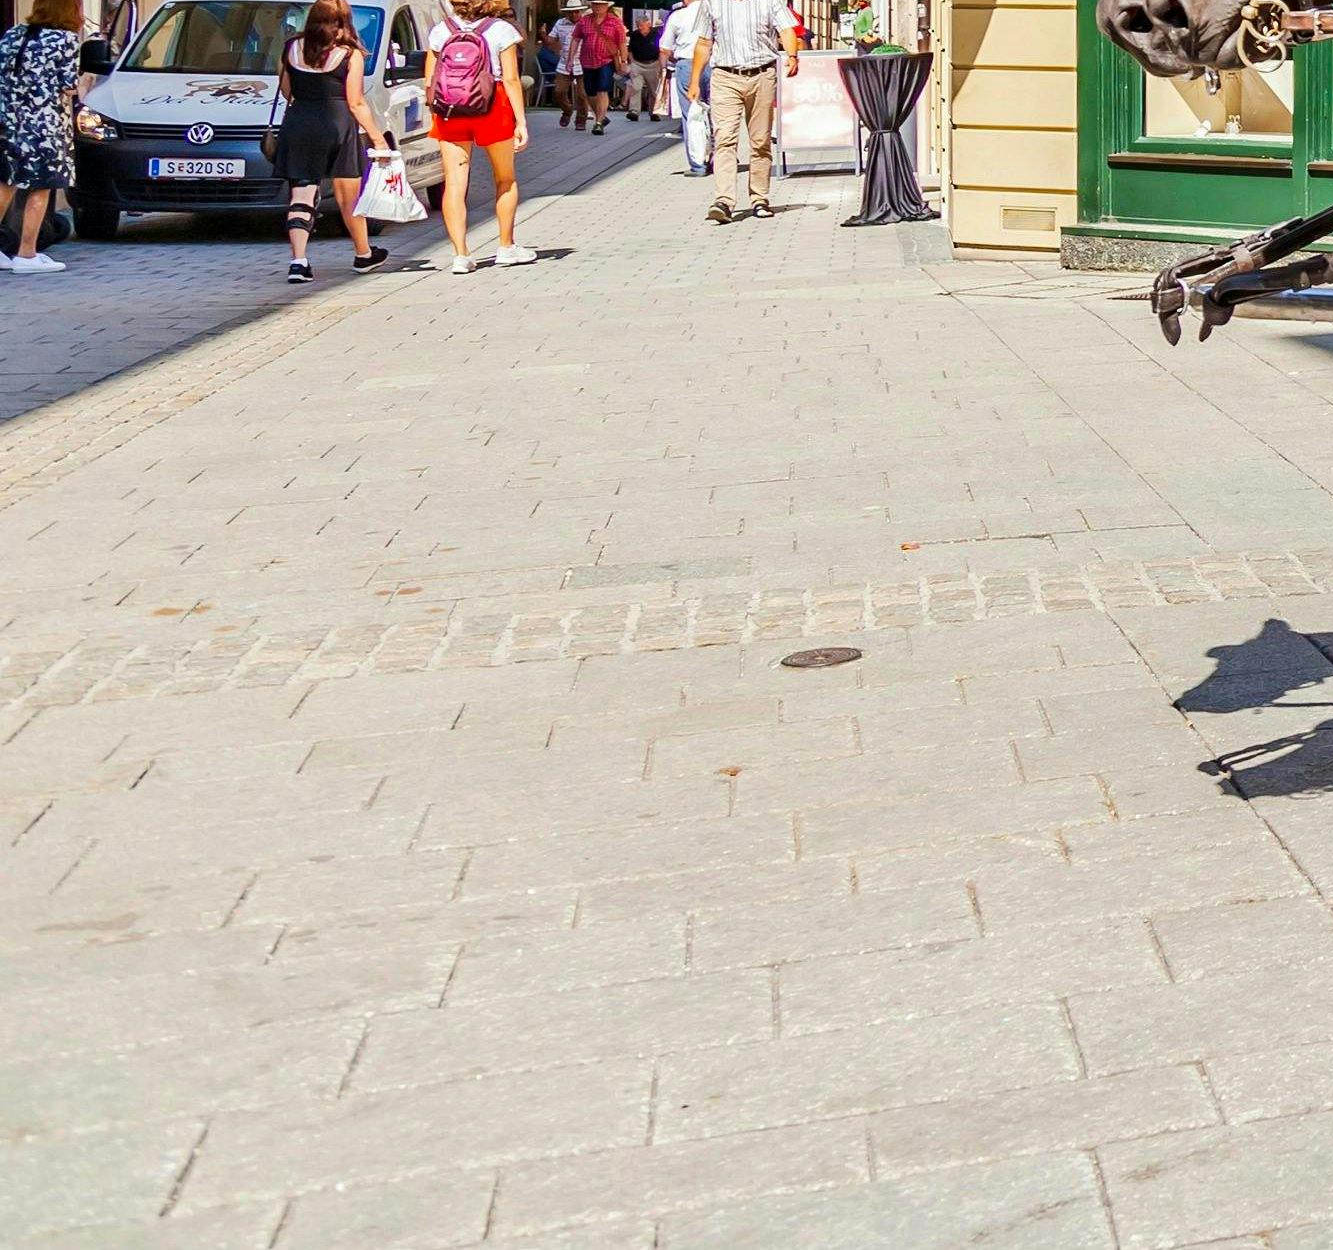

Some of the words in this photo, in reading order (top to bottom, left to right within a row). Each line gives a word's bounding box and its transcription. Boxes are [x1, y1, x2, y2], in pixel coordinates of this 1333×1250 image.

[167, 162, 176, 174] S
[186, 162, 213, 175] 320
[216, 162, 235, 175] SC
